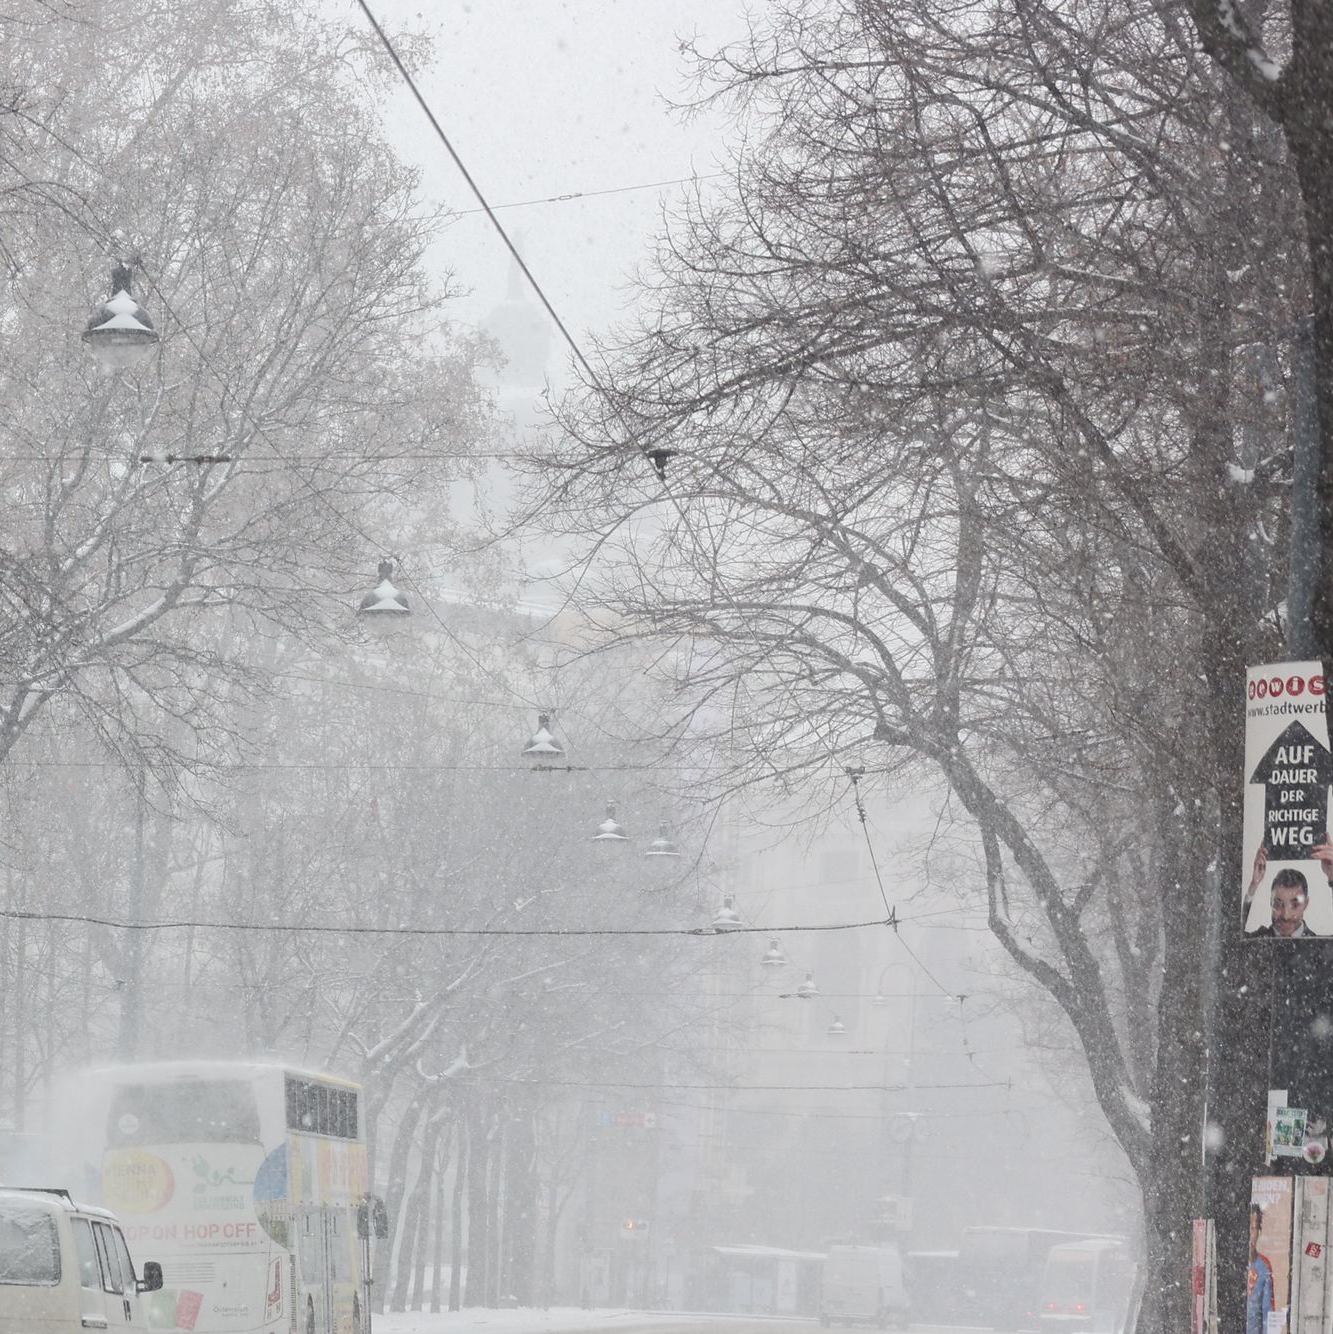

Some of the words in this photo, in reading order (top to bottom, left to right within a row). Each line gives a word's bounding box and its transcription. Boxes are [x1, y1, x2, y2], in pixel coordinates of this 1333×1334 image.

[1275, 745, 1314, 765] AUF
[1270, 769, 1318, 784] DAUER
[1280, 789, 1305, 803] DER
[1268, 808, 1319, 822] RICHTIGE
[1271, 826, 1313, 846] WEG
[120, 1225, 149, 1241] OP
[183, 1223, 220, 1239] HOP
[223, 1222, 257, 1239] OFF
